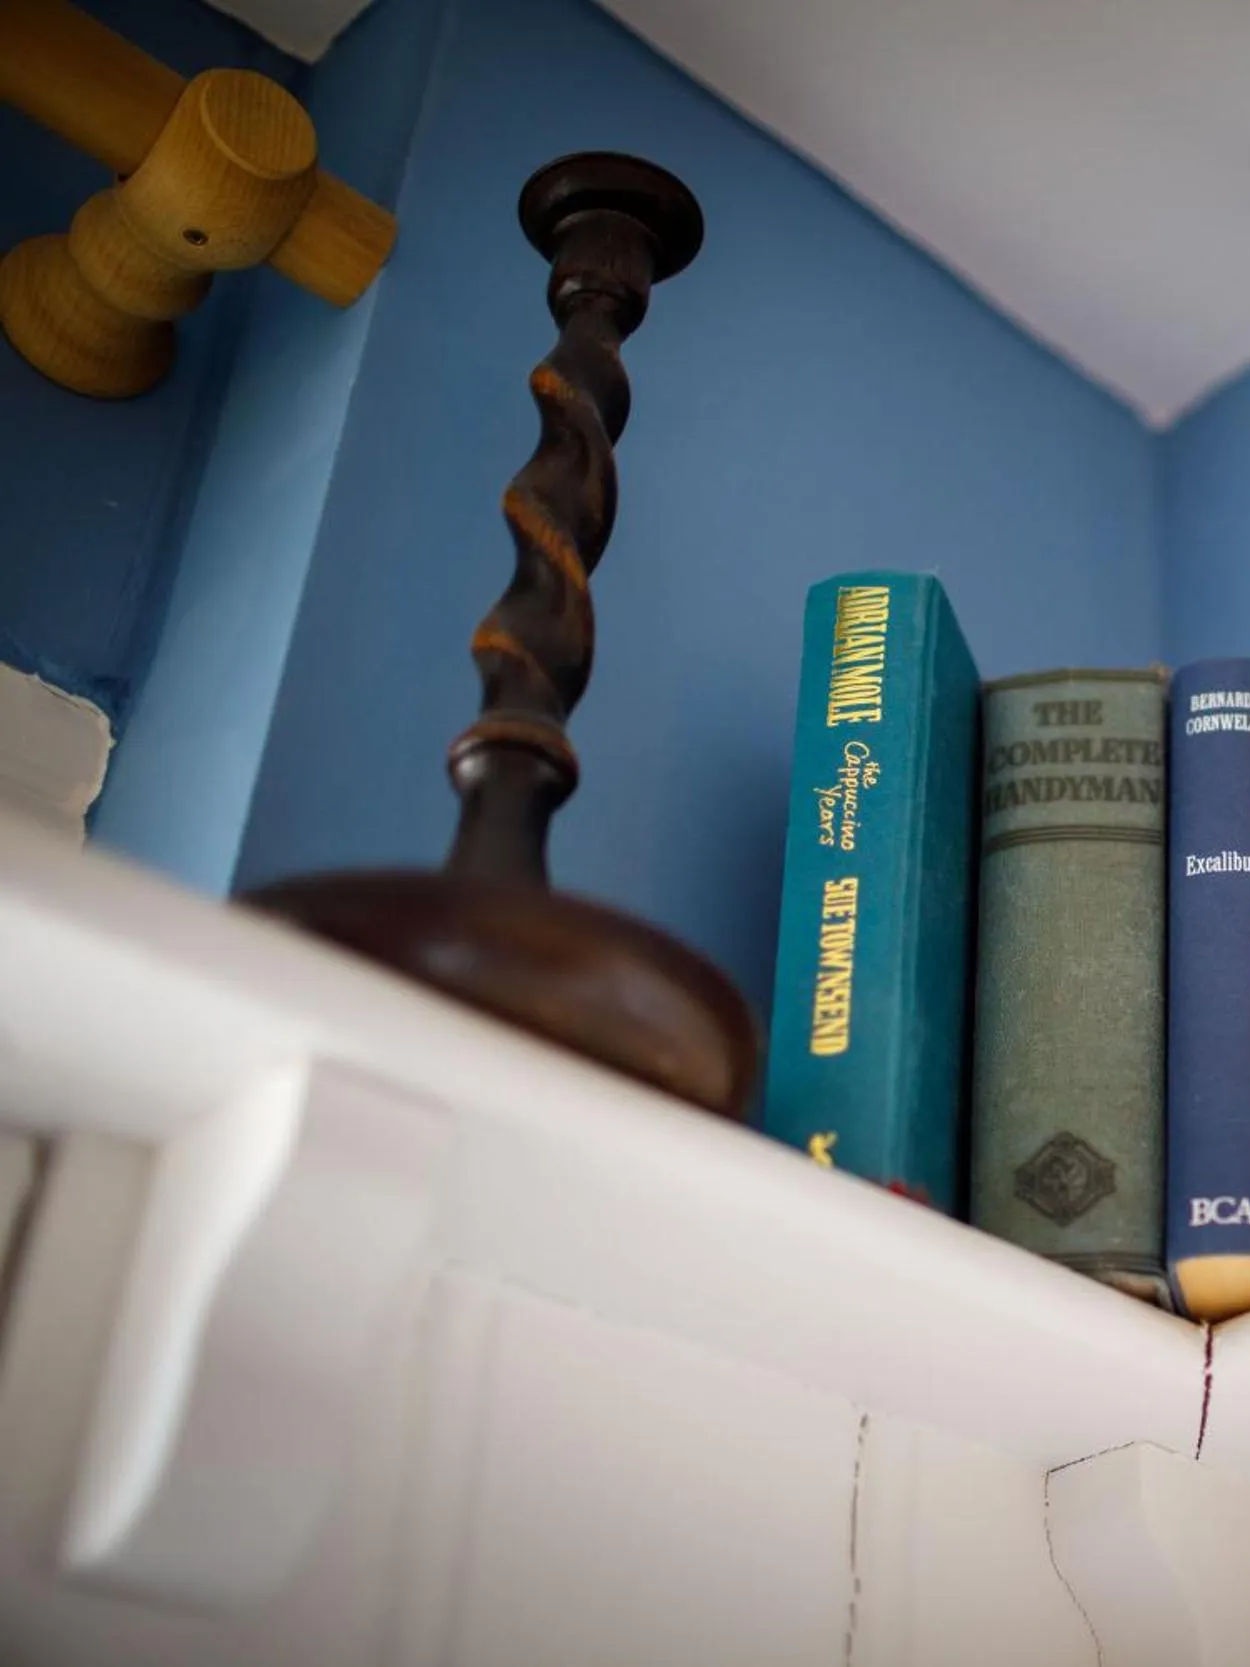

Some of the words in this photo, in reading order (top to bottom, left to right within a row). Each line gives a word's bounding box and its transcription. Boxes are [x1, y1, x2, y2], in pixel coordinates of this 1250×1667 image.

[832, 586, 890, 666] ADRIAN
[826, 661, 885, 727] MOLE
[1034, 699, 1103, 726] THE
[863, 761, 881, 789] the
[987, 736, 1161, 775] COMPLETE
[813, 784, 843, 847] Years
[837, 741, 870, 851] Cappuccino
[823, 877, 859, 920] SUE
[810, 918, 856, 1056] TOWNSEND
